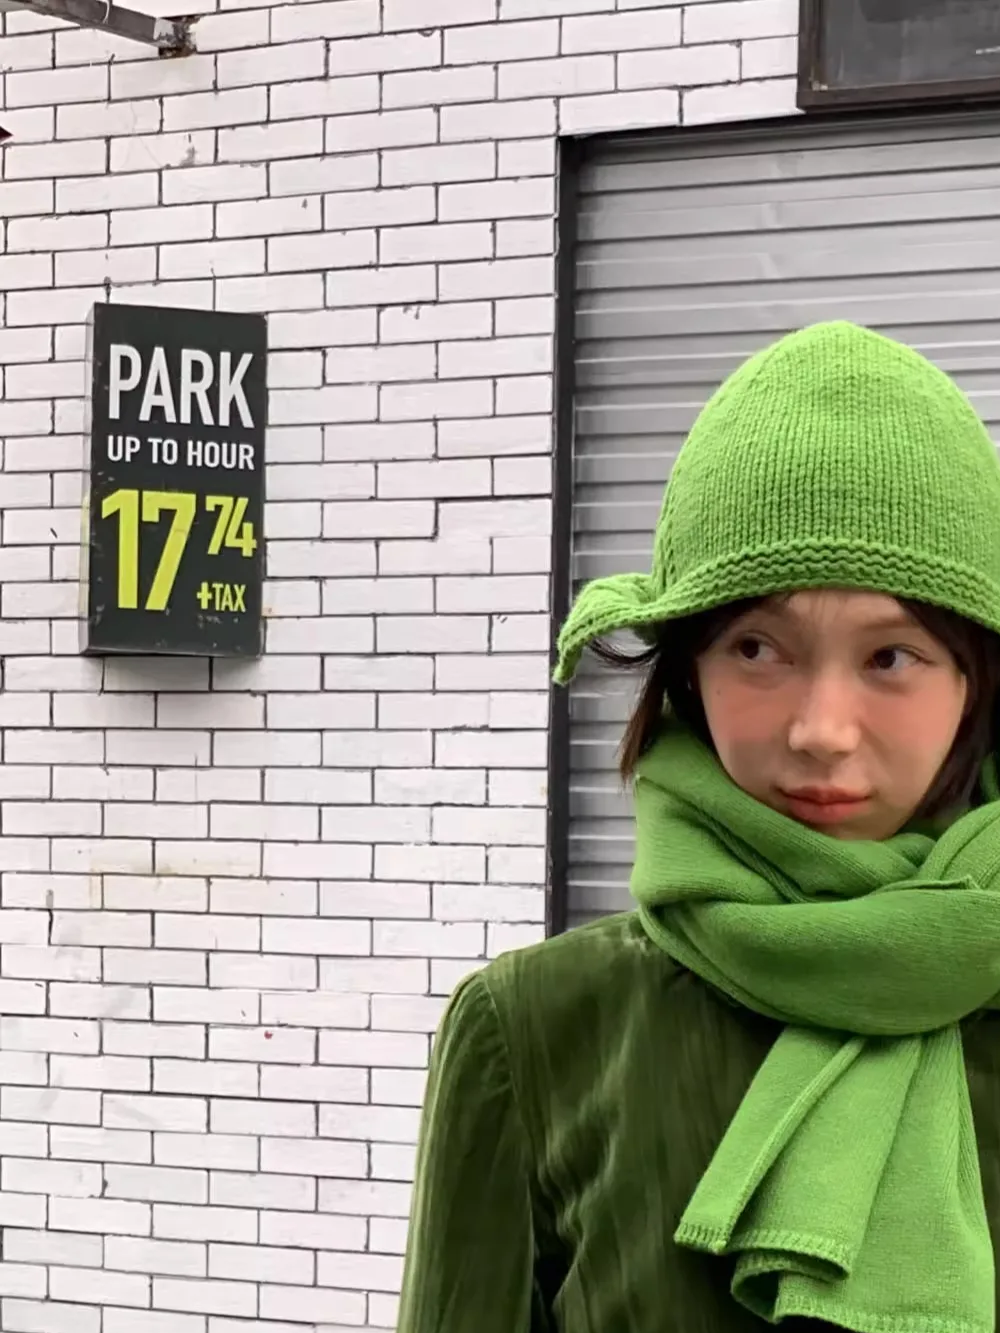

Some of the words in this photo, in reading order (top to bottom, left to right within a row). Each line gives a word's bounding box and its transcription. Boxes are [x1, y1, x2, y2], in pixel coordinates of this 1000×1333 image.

[108, 344, 255, 428] PARK
[107, 435, 140, 461] UP
[148, 437, 178, 465] TO
[187, 441, 255, 470] HOUR
[102, 489, 196, 610] 17
[205, 495, 257, 557] 74
